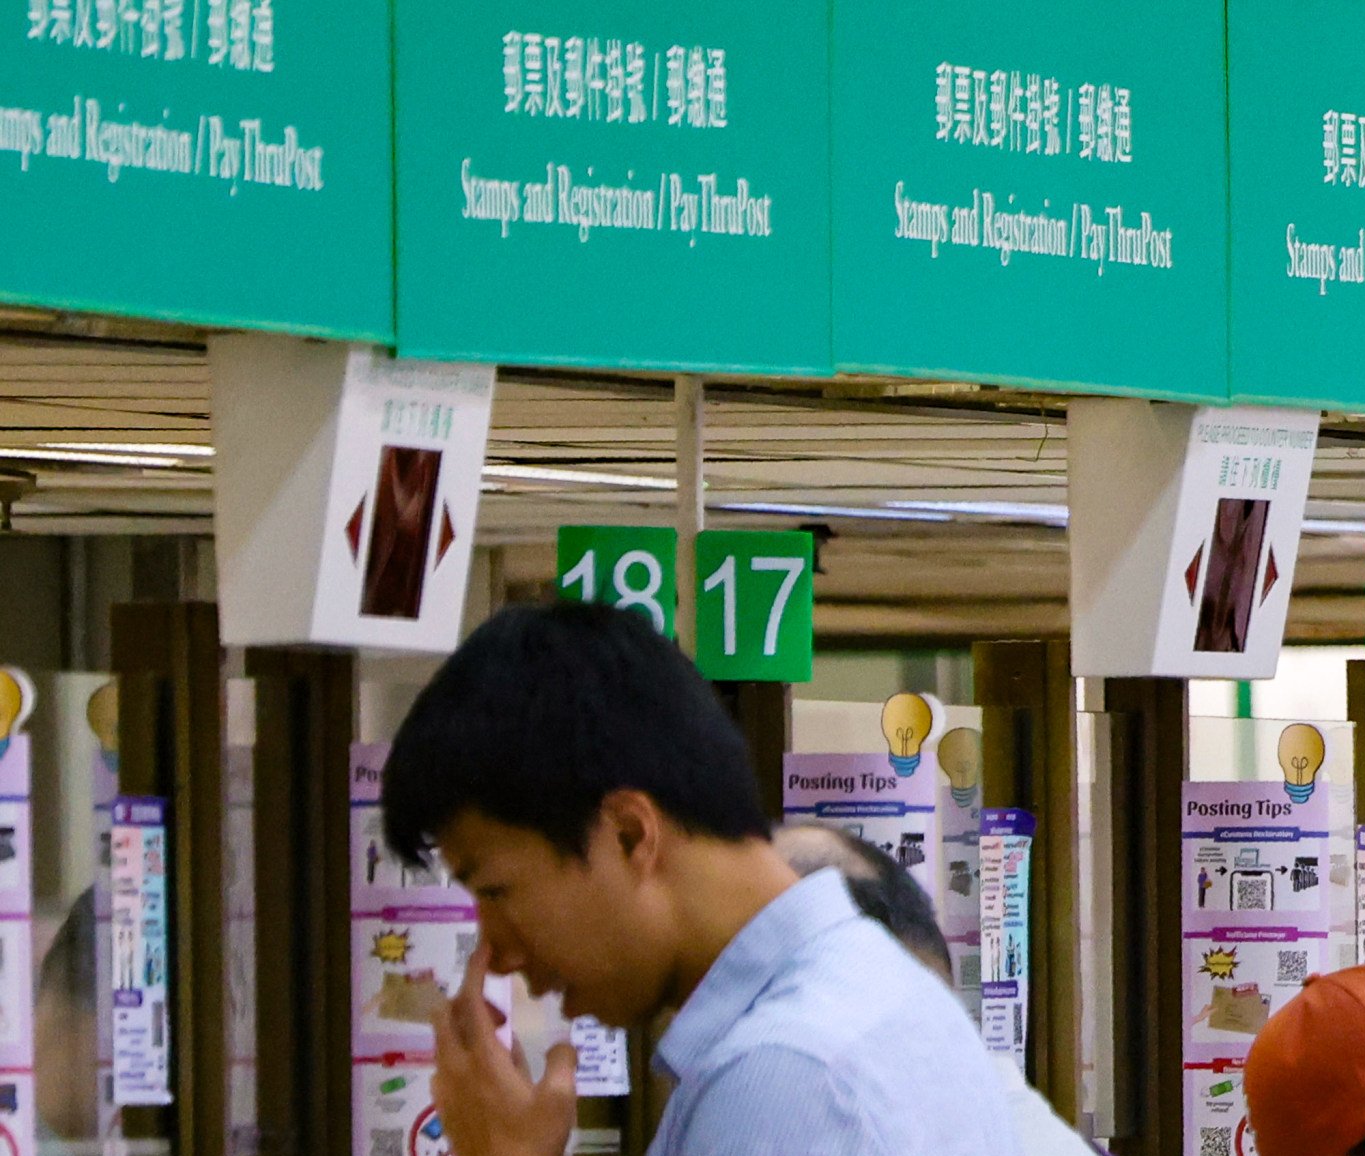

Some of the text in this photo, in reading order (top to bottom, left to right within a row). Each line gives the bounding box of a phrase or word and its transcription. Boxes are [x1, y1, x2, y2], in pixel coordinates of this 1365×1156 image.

[0, 107, 43, 171] mps
[47, 95, 81, 159] and
[85, 98, 192, 183] Registration
[461, 157, 520, 238] Stamps
[523, 161, 554, 223] and
[557, 164, 655, 243] Registration
[895, 180, 948, 258] Stamps
[951, 188, 979, 247] and
[982, 191, 1067, 266] Registration
[1286, 222, 1336, 295] Stamps
[1339, 227, 1365, 283] and
[562, 550, 665, 635] 18
[704, 555, 805, 656] 17
[788, 773, 897, 792] Posting Tips
[1186, 799, 1293, 818] Posting Tips
